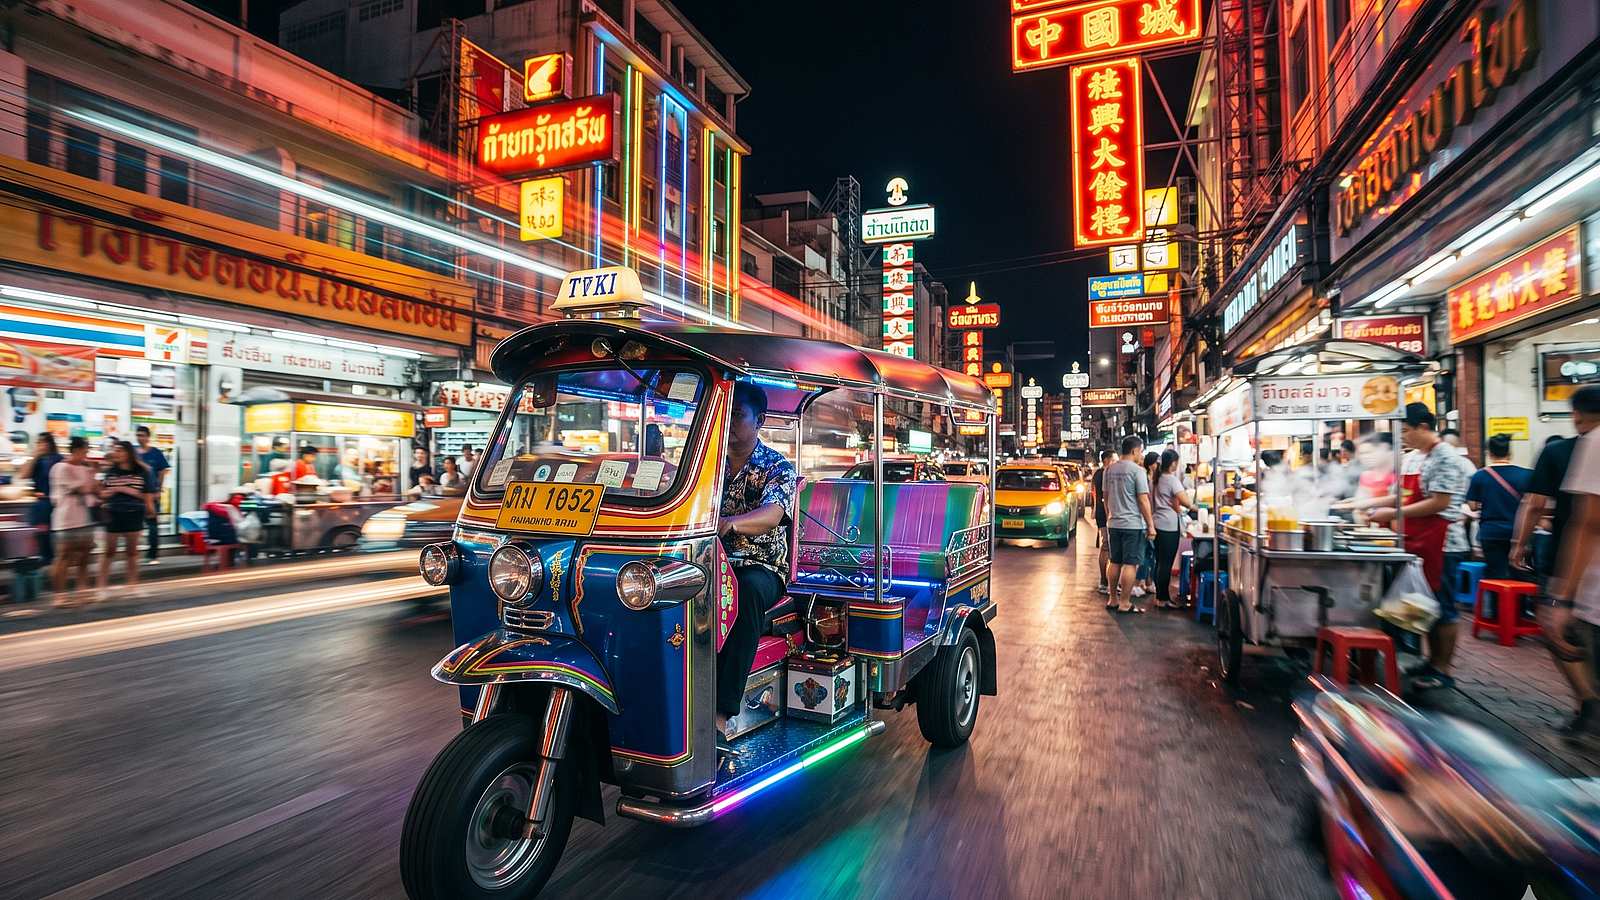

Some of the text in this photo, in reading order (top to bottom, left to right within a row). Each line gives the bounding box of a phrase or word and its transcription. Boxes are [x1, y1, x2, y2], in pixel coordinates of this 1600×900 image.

[1026, 0, 1184, 59] 中國城
[545, 486, 595, 513] 1052
